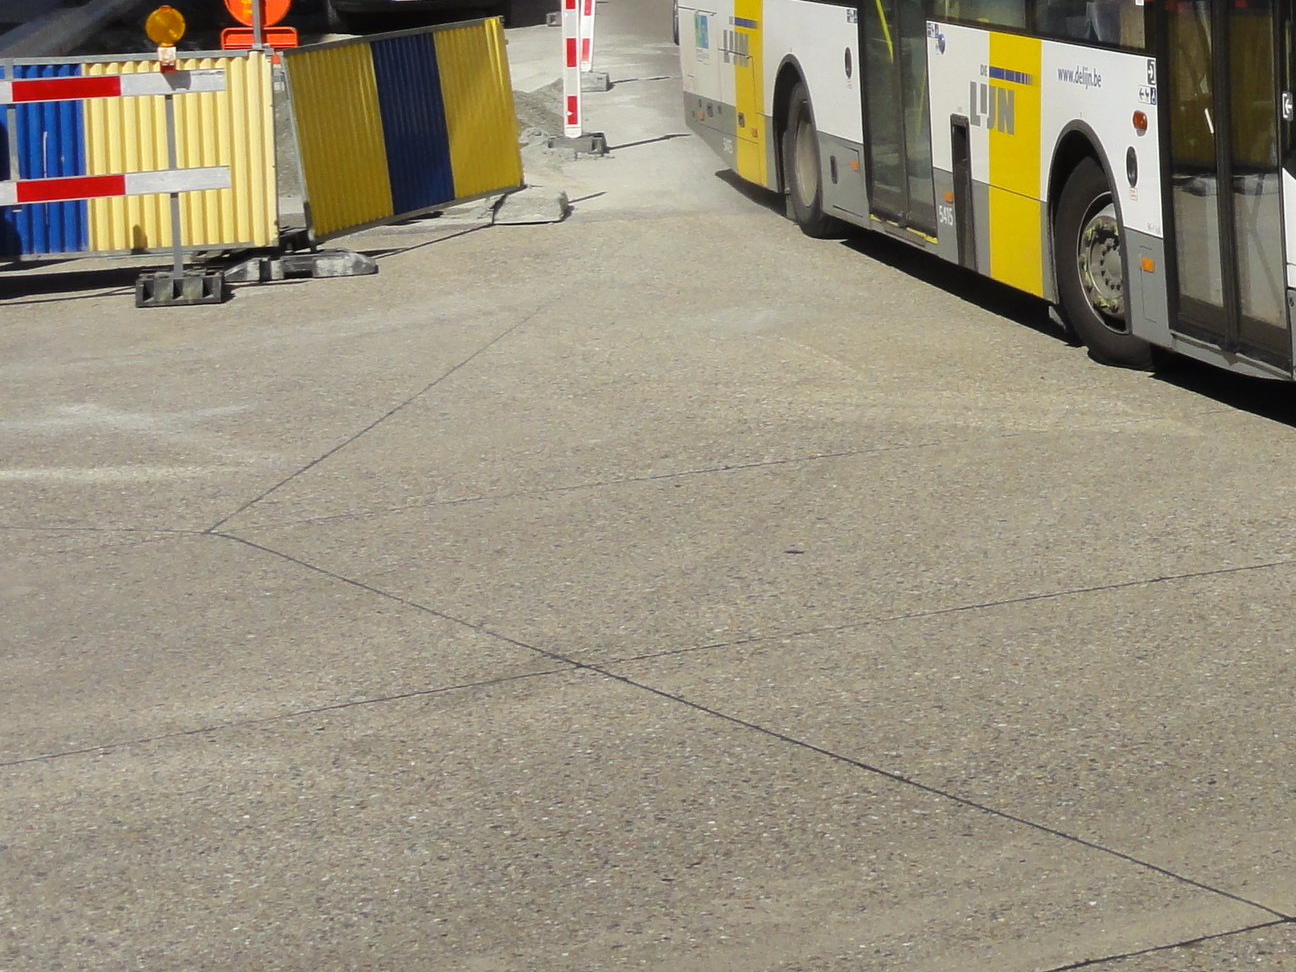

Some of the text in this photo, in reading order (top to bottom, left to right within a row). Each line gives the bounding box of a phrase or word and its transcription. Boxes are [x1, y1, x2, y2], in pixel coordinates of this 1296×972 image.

[980, 63, 988, 77] DE
[1057, 65, 1102, 90] www.delijn.be
[969, 81, 1016, 135] LIJN
[938, 204, 954, 226] 5415
